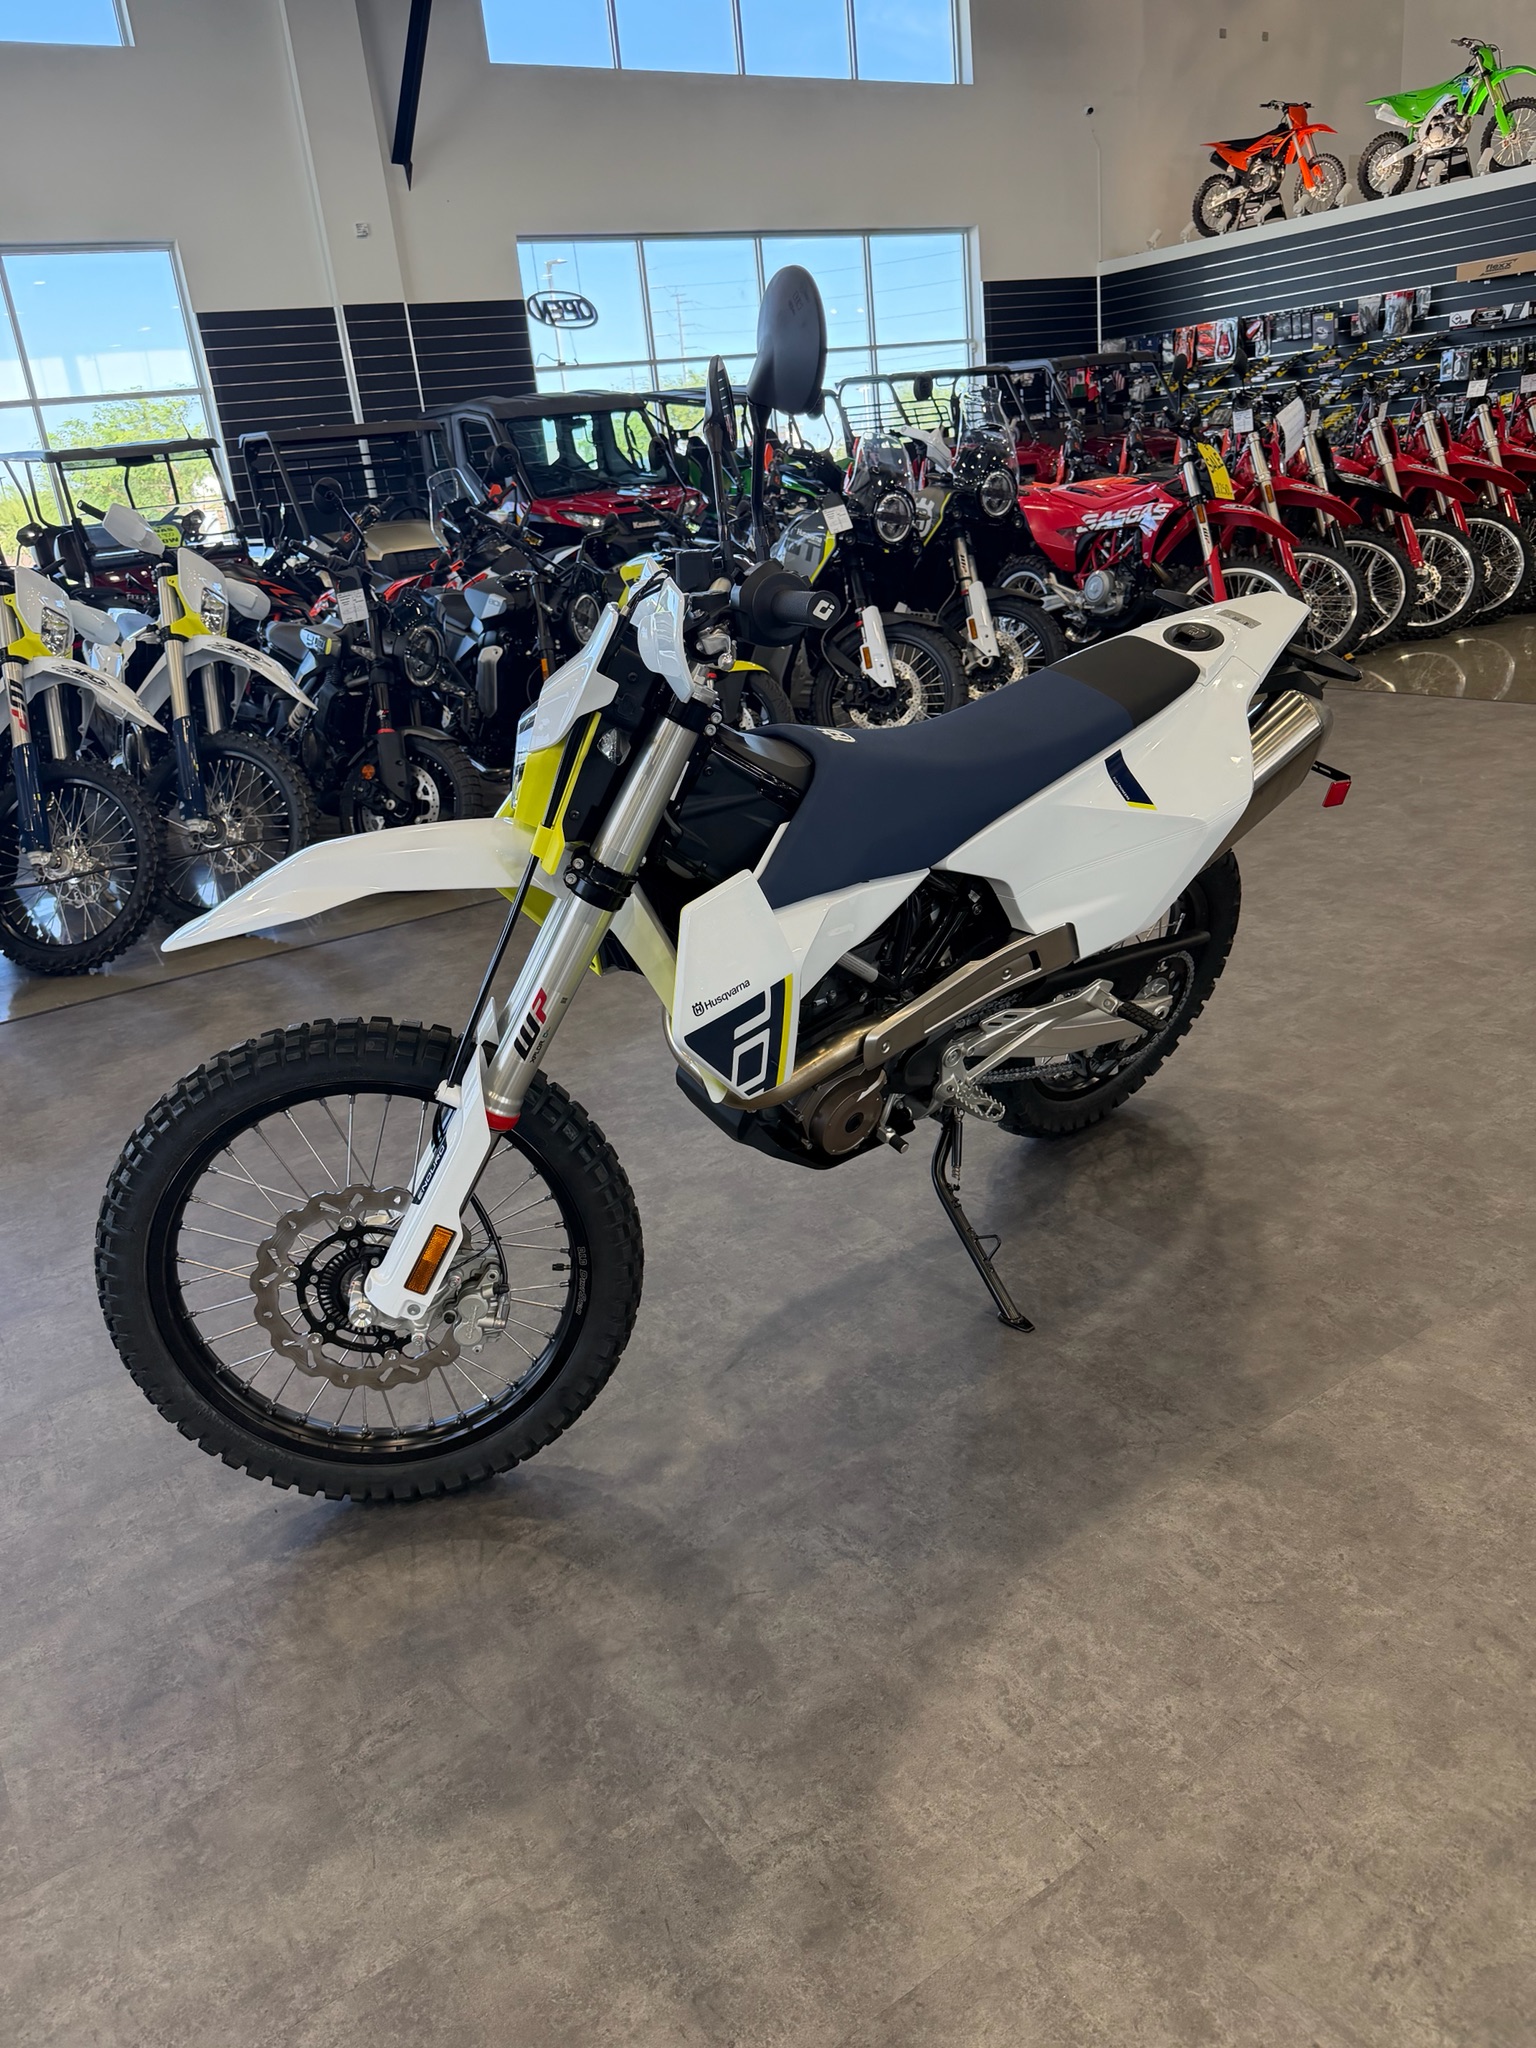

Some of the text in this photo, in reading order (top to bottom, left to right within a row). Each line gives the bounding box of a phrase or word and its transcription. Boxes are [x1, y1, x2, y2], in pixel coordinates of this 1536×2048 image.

[1076, 502, 1174, 534] GASGAS
[705, 979, 751, 1011] Husqvarna
[513, 986, 547, 1061] WP
[529, 1040, 545, 1064] XPLOR
[416, 1144, 445, 1201] ENDURO
